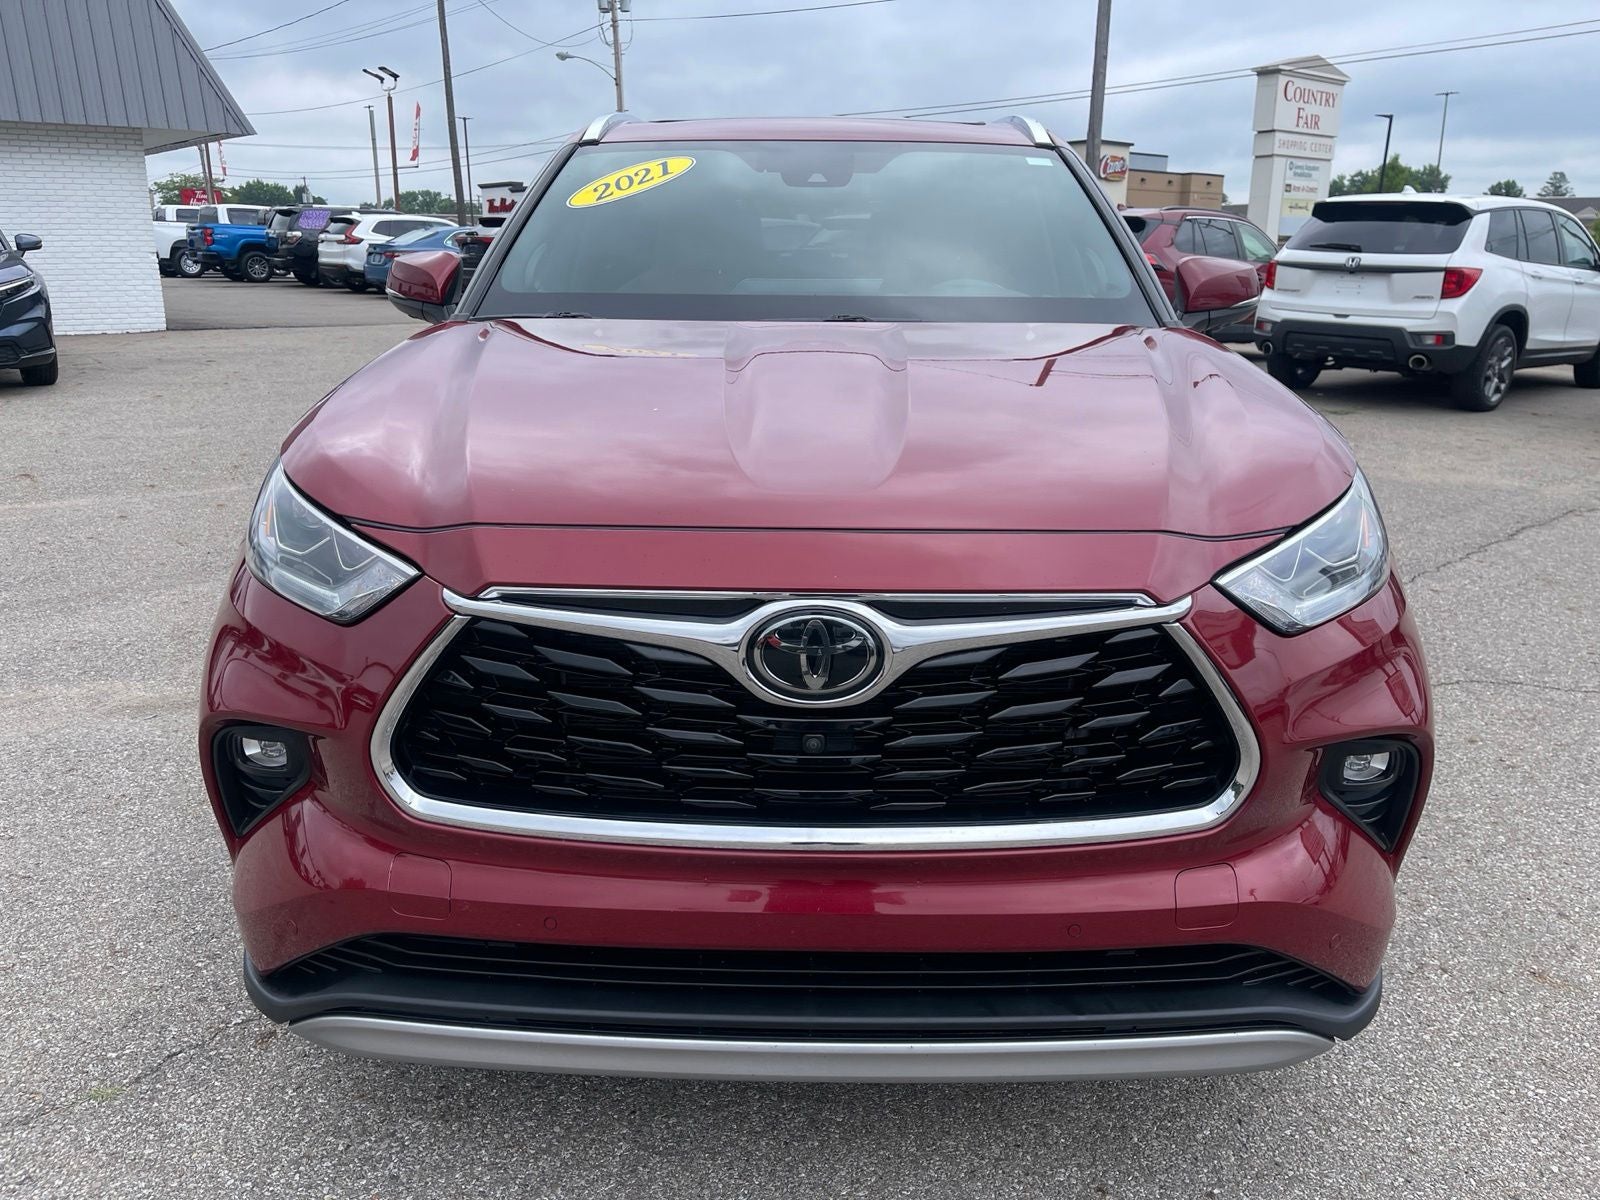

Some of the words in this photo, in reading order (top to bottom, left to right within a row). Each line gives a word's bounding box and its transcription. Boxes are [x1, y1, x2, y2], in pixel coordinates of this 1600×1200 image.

[1284, 79, 1338, 108] COUNTRY
[1295, 107, 1320, 130] FAIR
[1278, 138, 1308, 151] SHOPPING
[1310, 141, 1333, 153] CENTER
[593, 160, 674, 202] 2021
